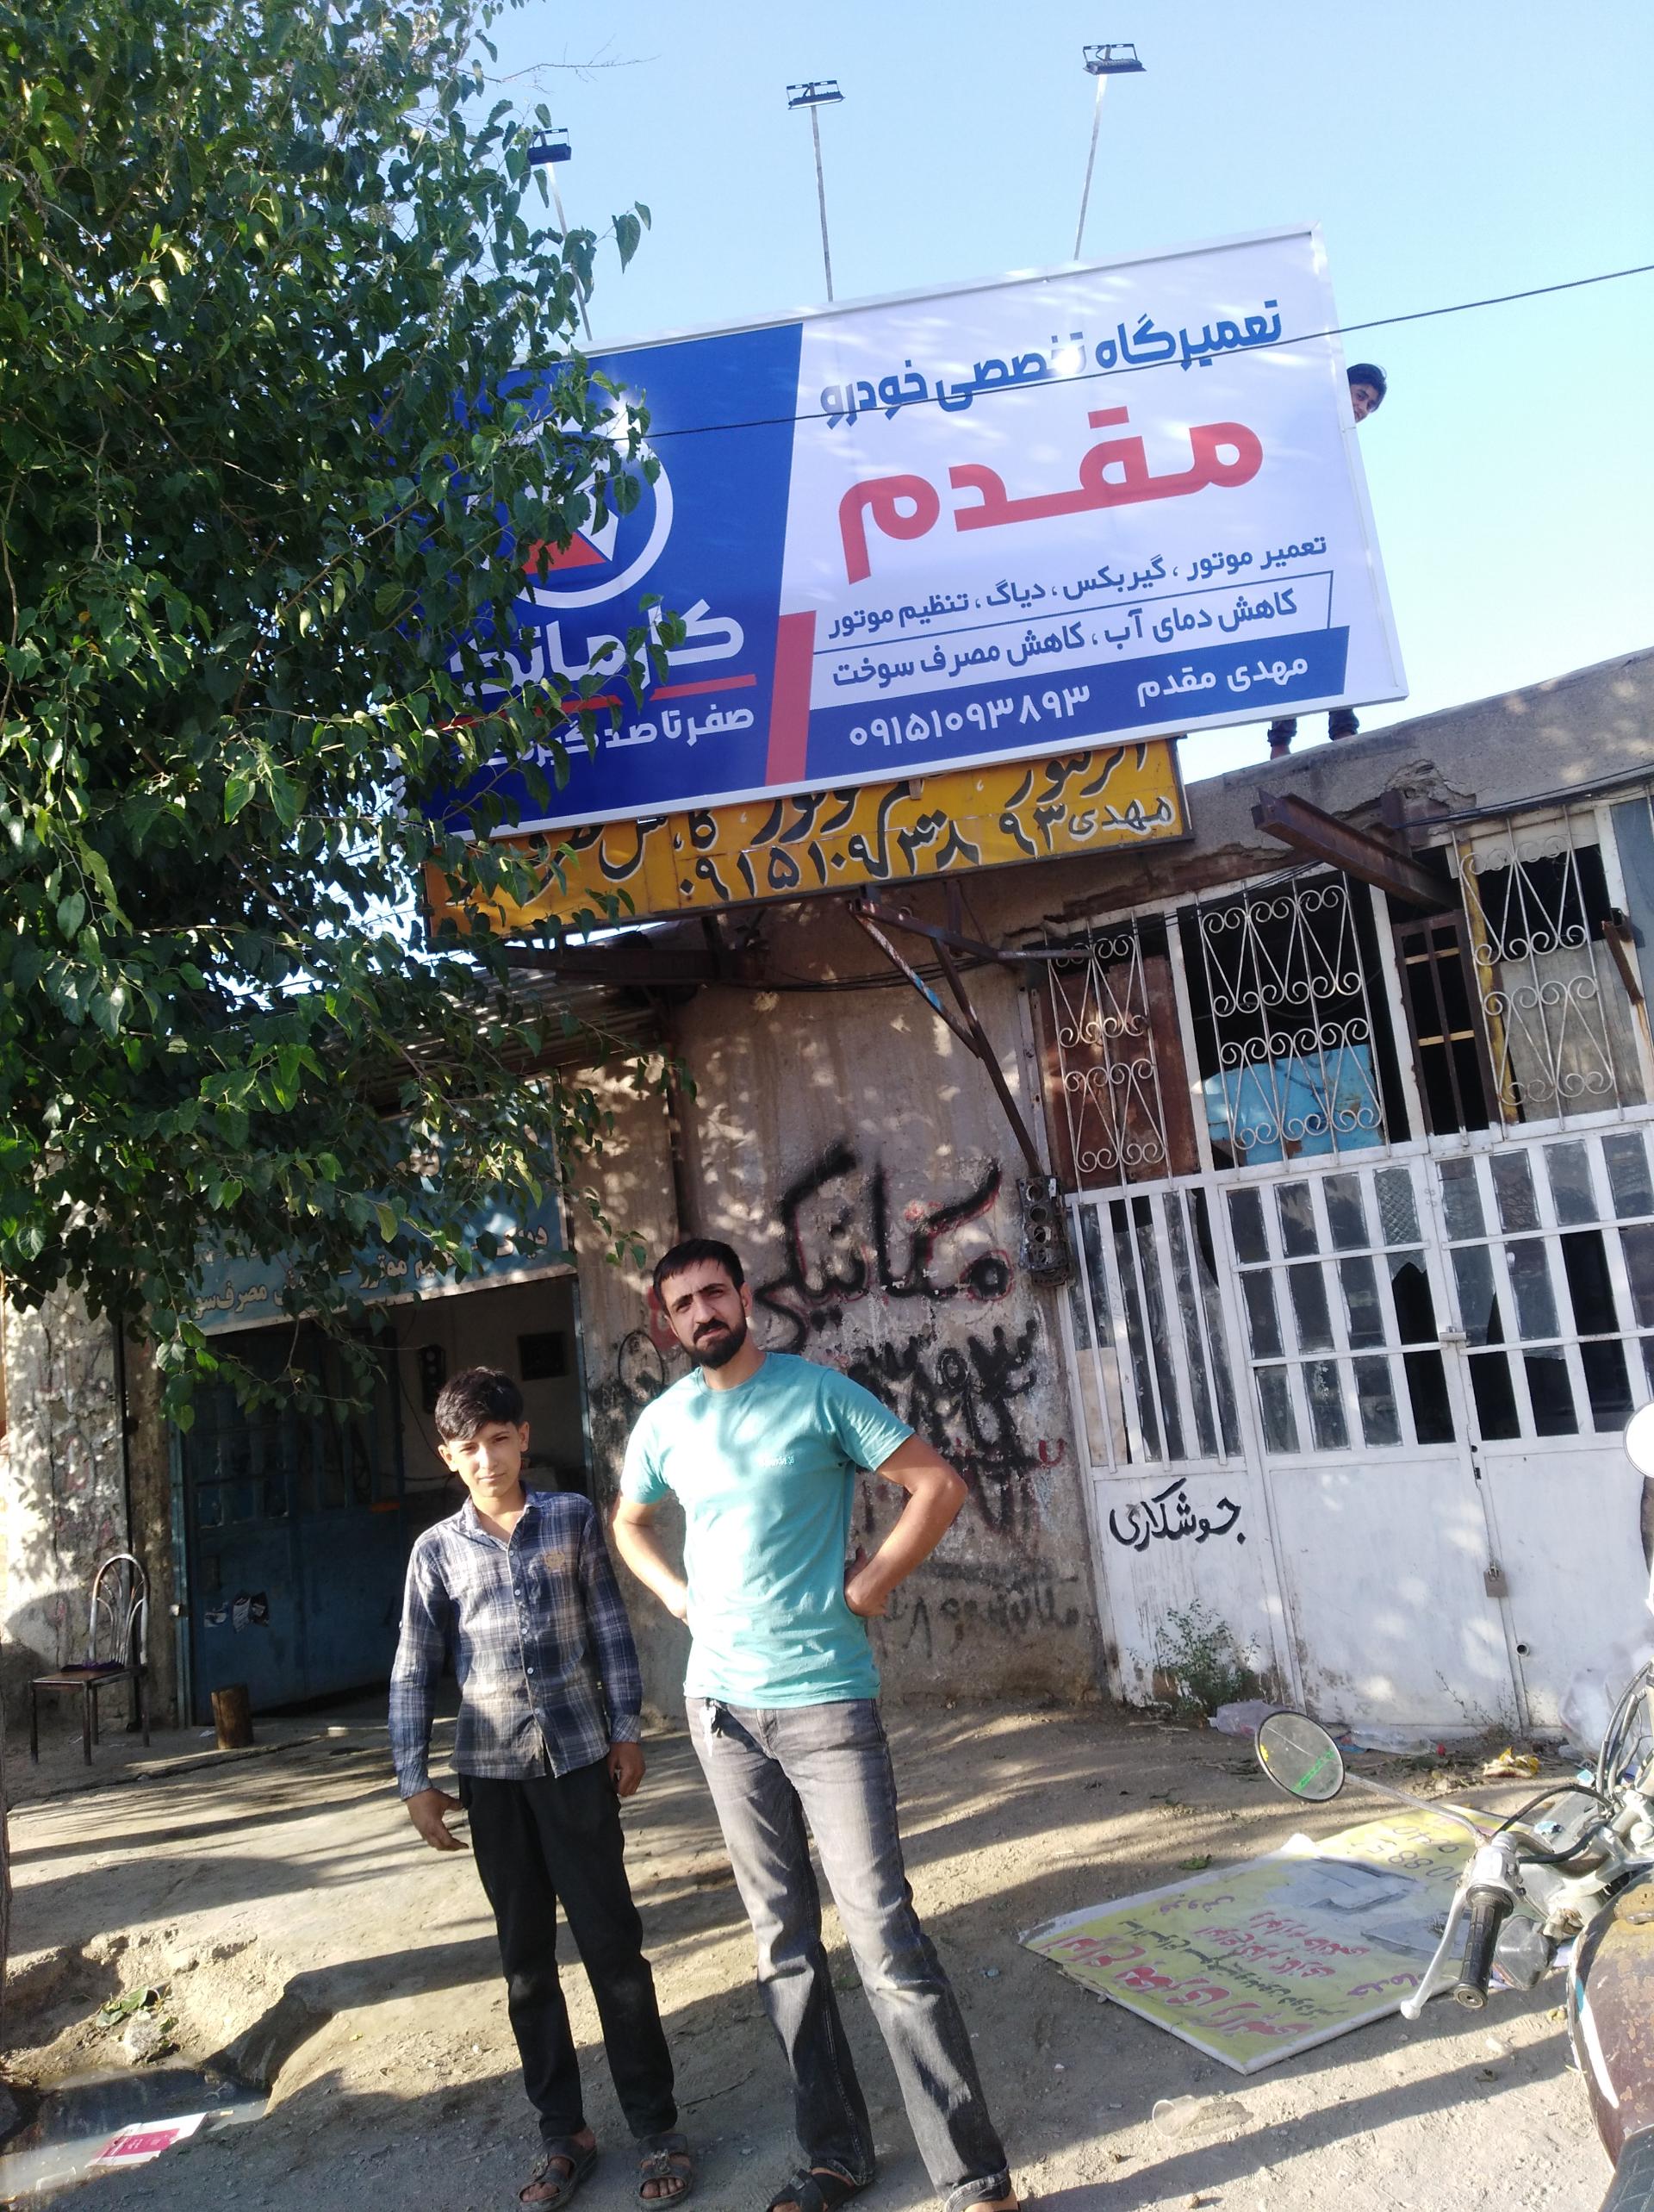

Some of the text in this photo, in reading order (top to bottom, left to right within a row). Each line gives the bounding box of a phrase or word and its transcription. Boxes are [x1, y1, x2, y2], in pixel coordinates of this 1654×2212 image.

[1095, 299, 1282, 371] تعمیرگاه
[819, 359, 929, 429] خودرو
[837, 406, 1264, 585] مقدم
[1259, 536, 1328, 570] تعمیر
[828, 607, 894, 639] موتور
[899, 593, 970, 628] تنظیم
[1152, 607, 1213, 643] دمای
[1218, 588, 1297, 632] کاهش
[920, 645, 1001, 677] مصرف
[1006, 620, 1085, 667] کاهش
[831, 657, 915, 689] سوخت
[849, 657, 1309, 747] مهدی مقدم ۰۹۱۵۱۰۹۳۸۹۳
[605, 722, 658, 749] صد
[661, 708, 682, 740] تا
[687, 703, 755, 747] صفر
[1068, 795, 1176, 842] مهدی
[1109, 1477, 1247, 1552] جوشکاری
[1346, 1972, 1421, 1997] خدما
